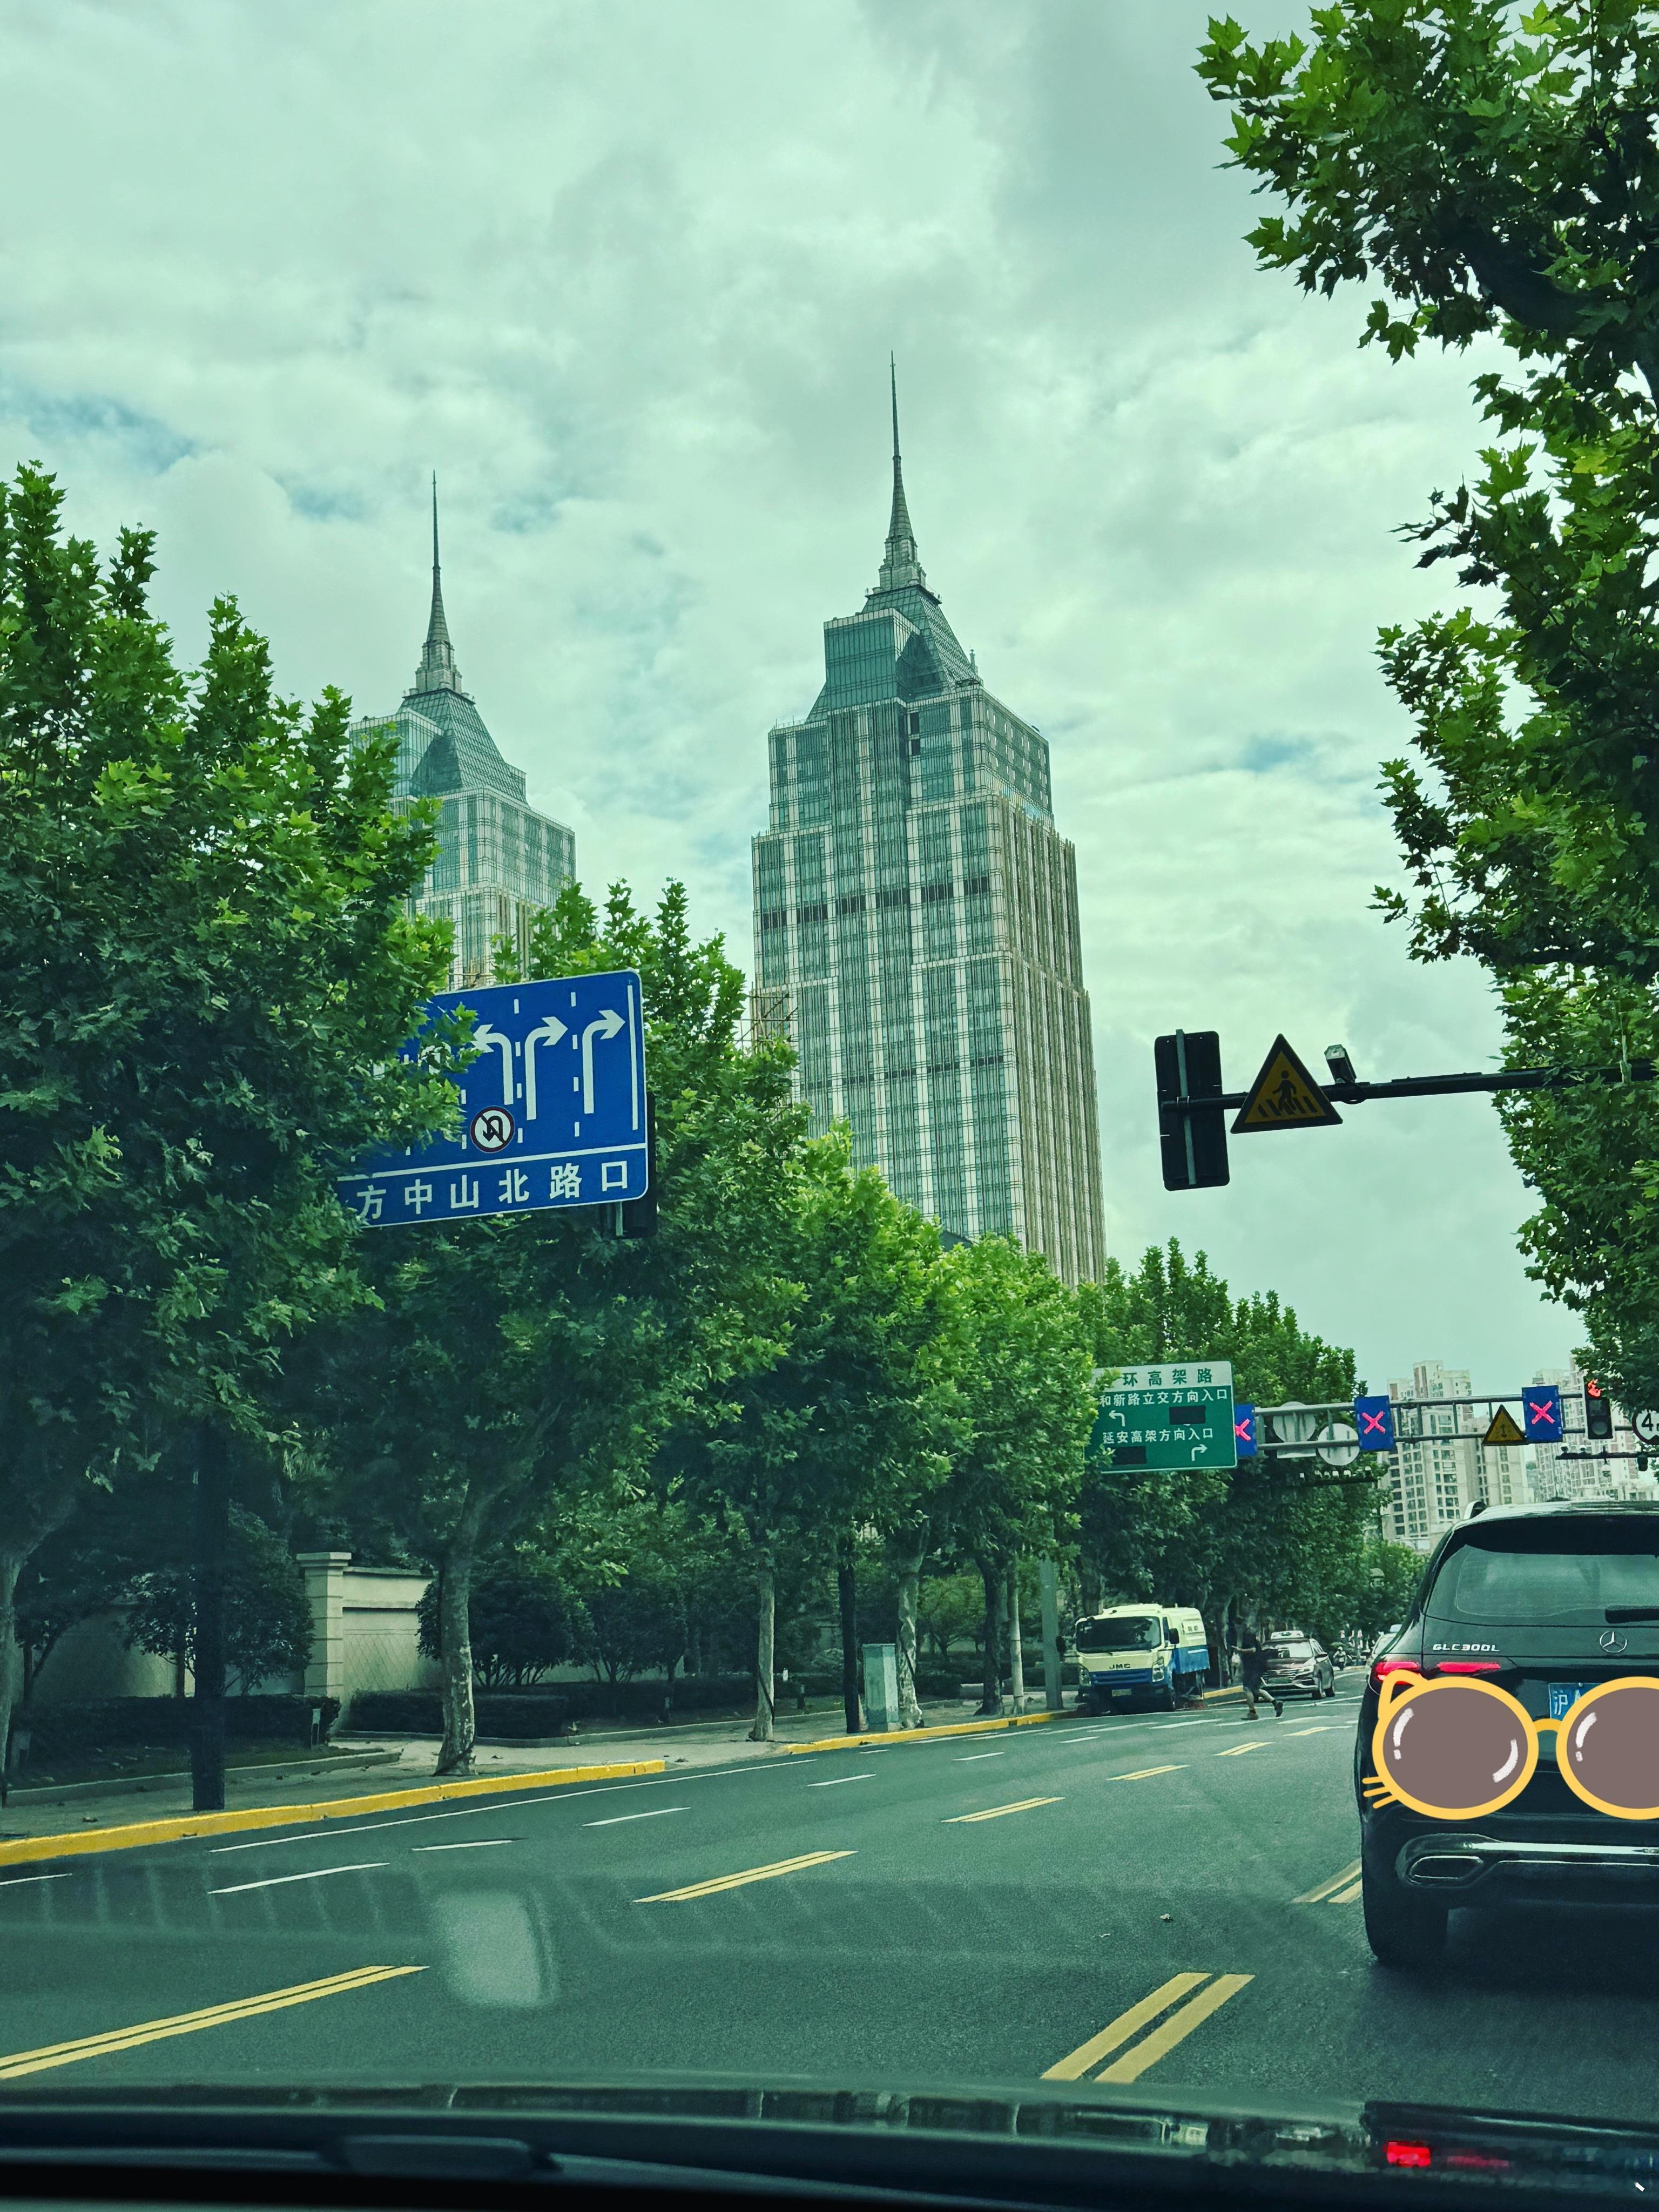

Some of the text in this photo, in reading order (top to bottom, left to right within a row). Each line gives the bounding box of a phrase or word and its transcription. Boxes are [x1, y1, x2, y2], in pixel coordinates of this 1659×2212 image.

[356, 1161, 628, 1219] 方中山北路口
[1102, 1427, 1213, 1444] 延安高架方向入口
